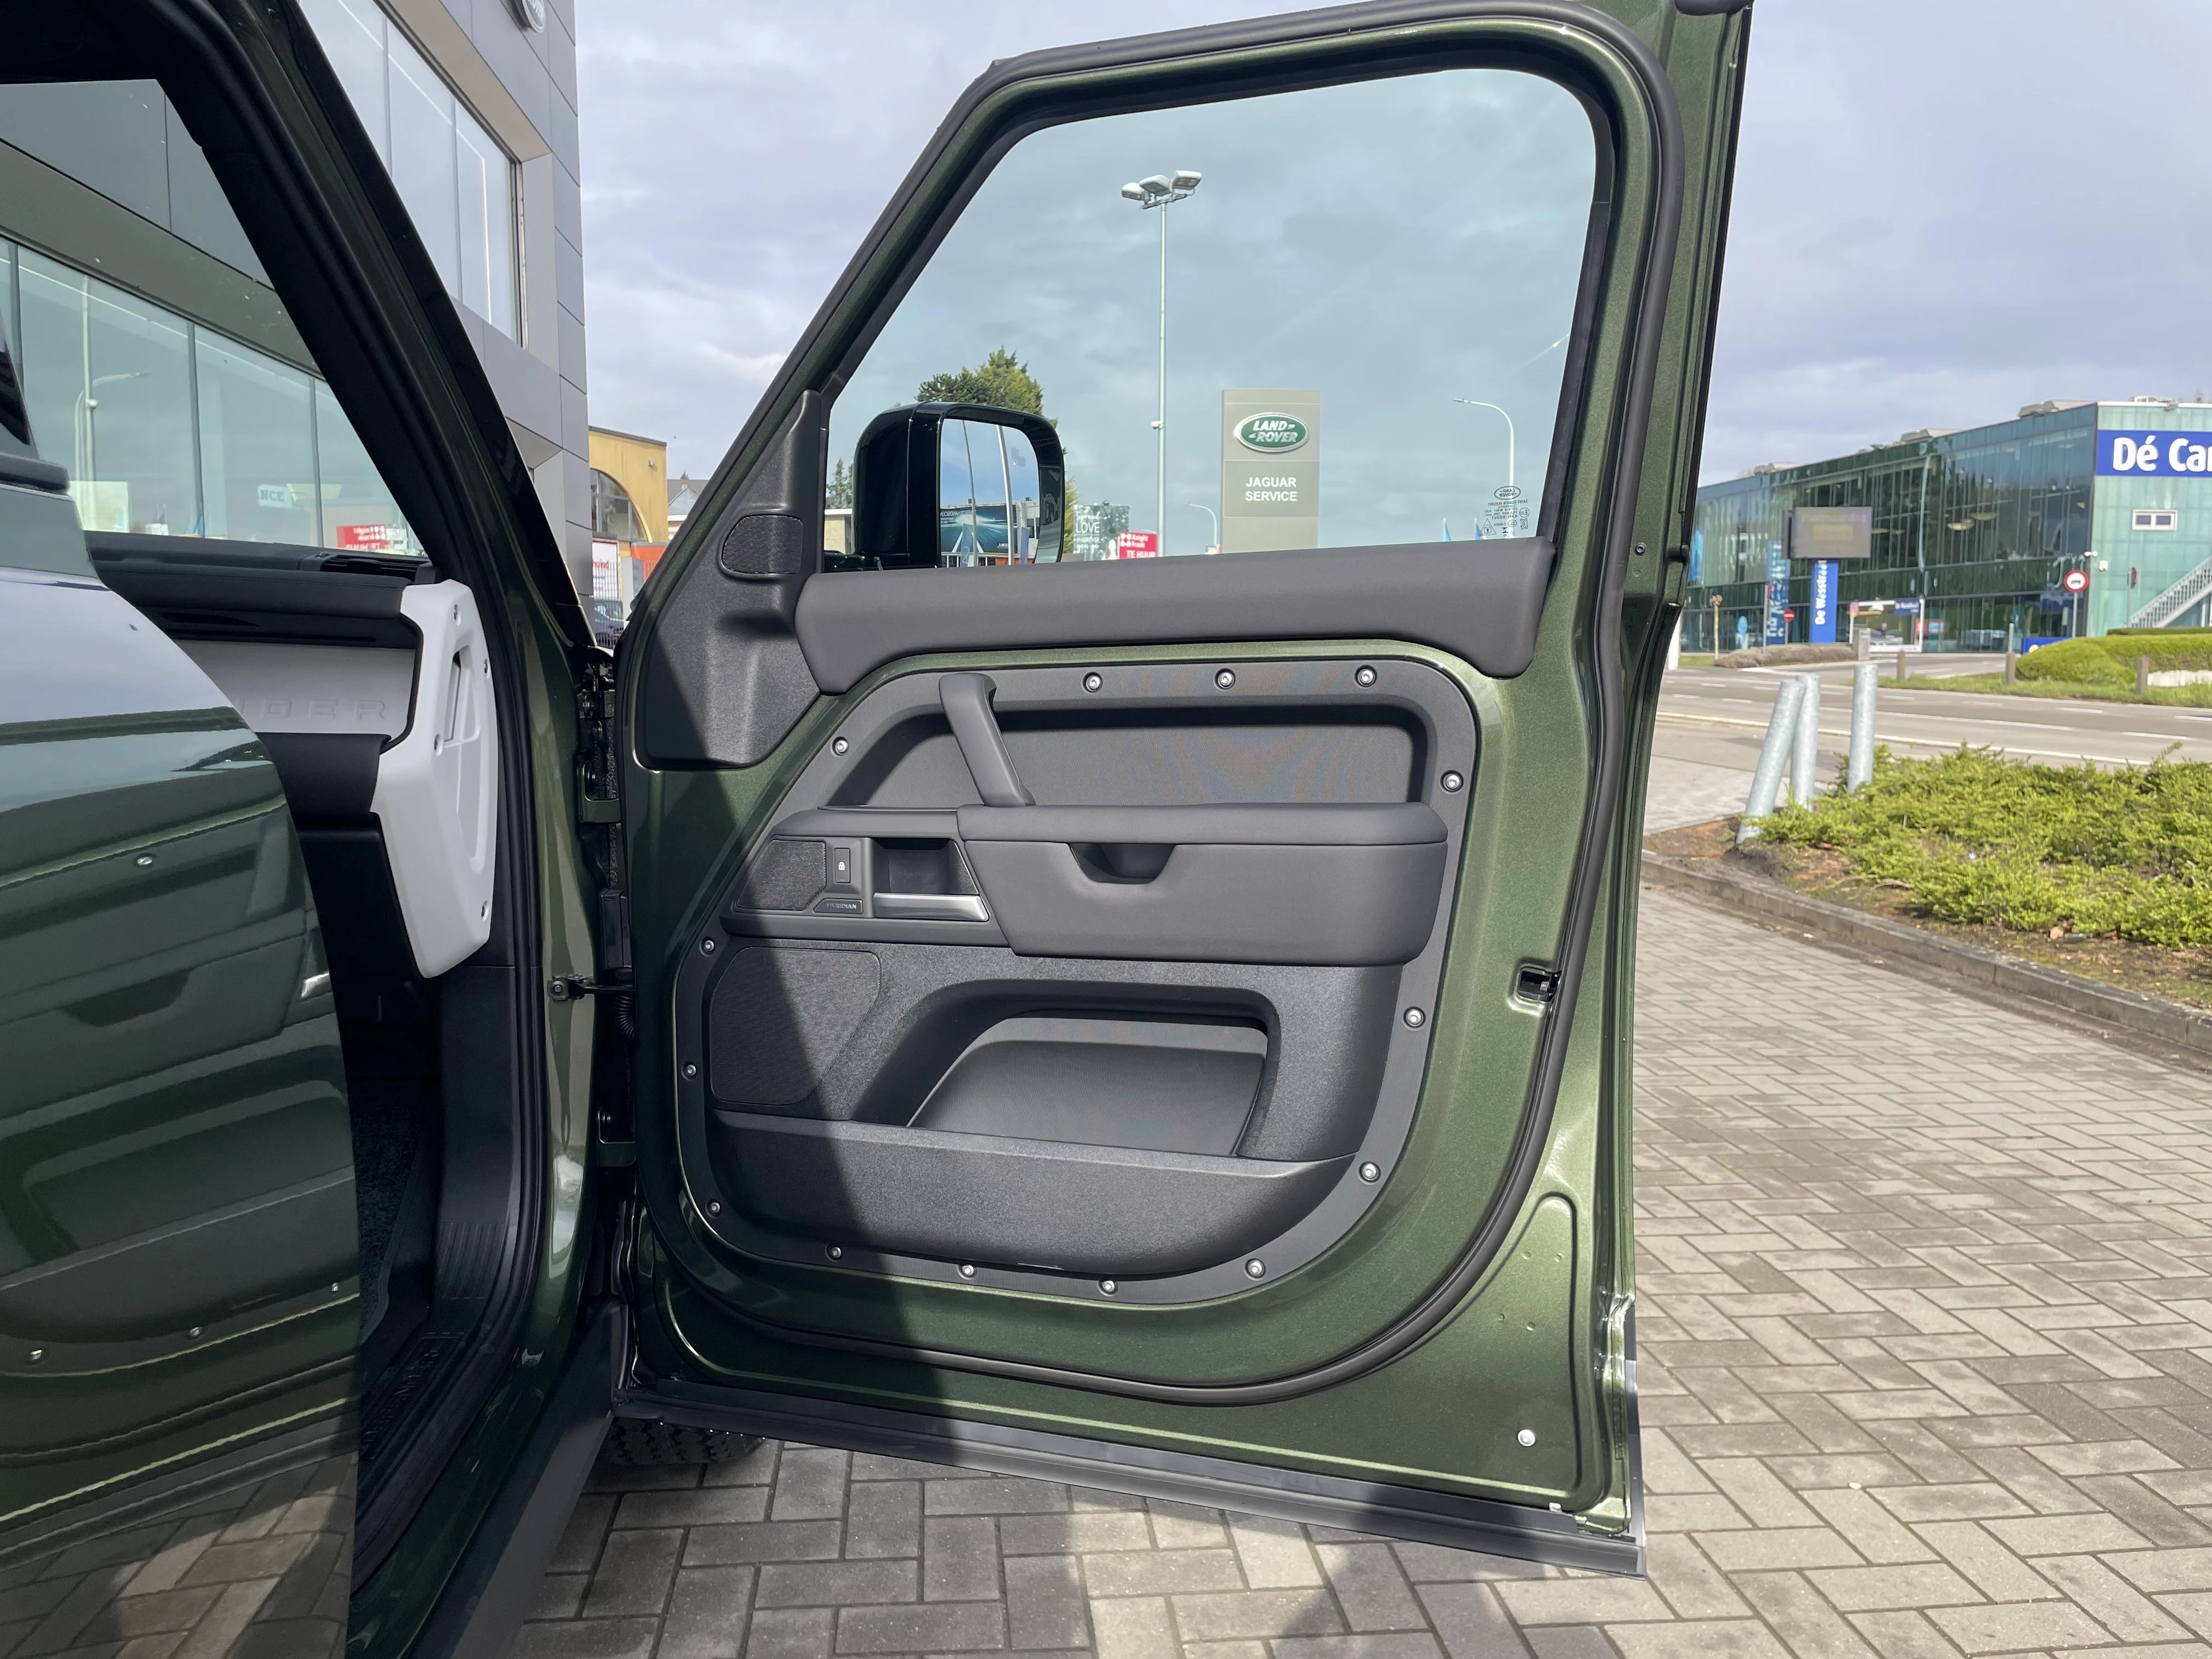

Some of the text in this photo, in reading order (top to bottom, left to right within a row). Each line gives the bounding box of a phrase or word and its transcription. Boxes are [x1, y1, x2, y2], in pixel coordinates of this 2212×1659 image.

[1253, 420, 1288, 431] LAND
[1255, 431, 1299, 442] ROVER
[2113, 435, 2159, 472] Dé
[1245, 477, 1297, 487] JAGUAR
[1245, 490, 1298, 501] SERVICE
[1075, 522, 1100, 533] LOVE
[1131, 534, 1149, 543] Knight
[1814, 610, 1826, 625] De
